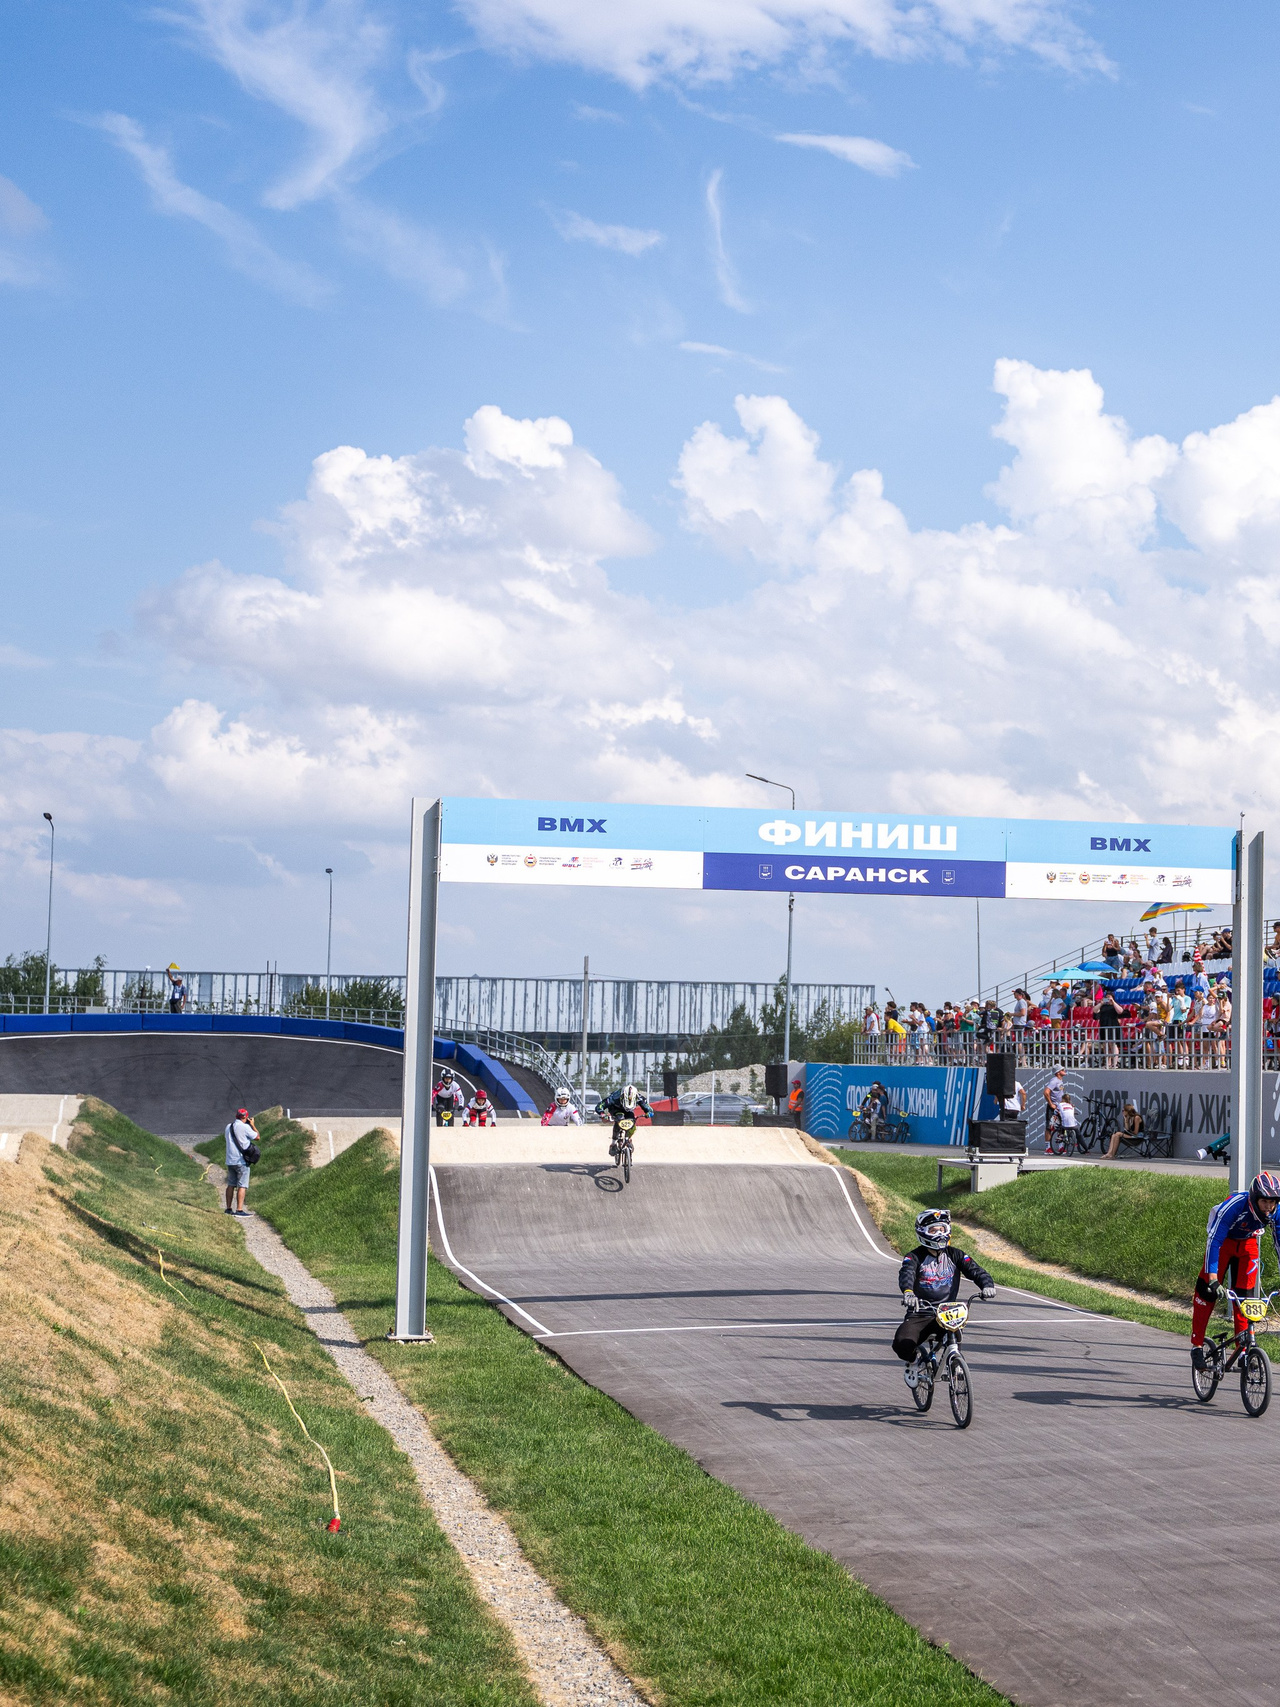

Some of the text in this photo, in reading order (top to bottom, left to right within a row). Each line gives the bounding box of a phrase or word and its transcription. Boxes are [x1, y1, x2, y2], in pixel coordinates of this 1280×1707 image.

[537, 816, 608, 833] BMX
[758, 819, 957, 851] ФИНИШ
[1090, 836, 1151, 852] BMX
[784, 865, 930, 884] САРАНСК
[907, 1087, 938, 1118] ЖИЗНИ
